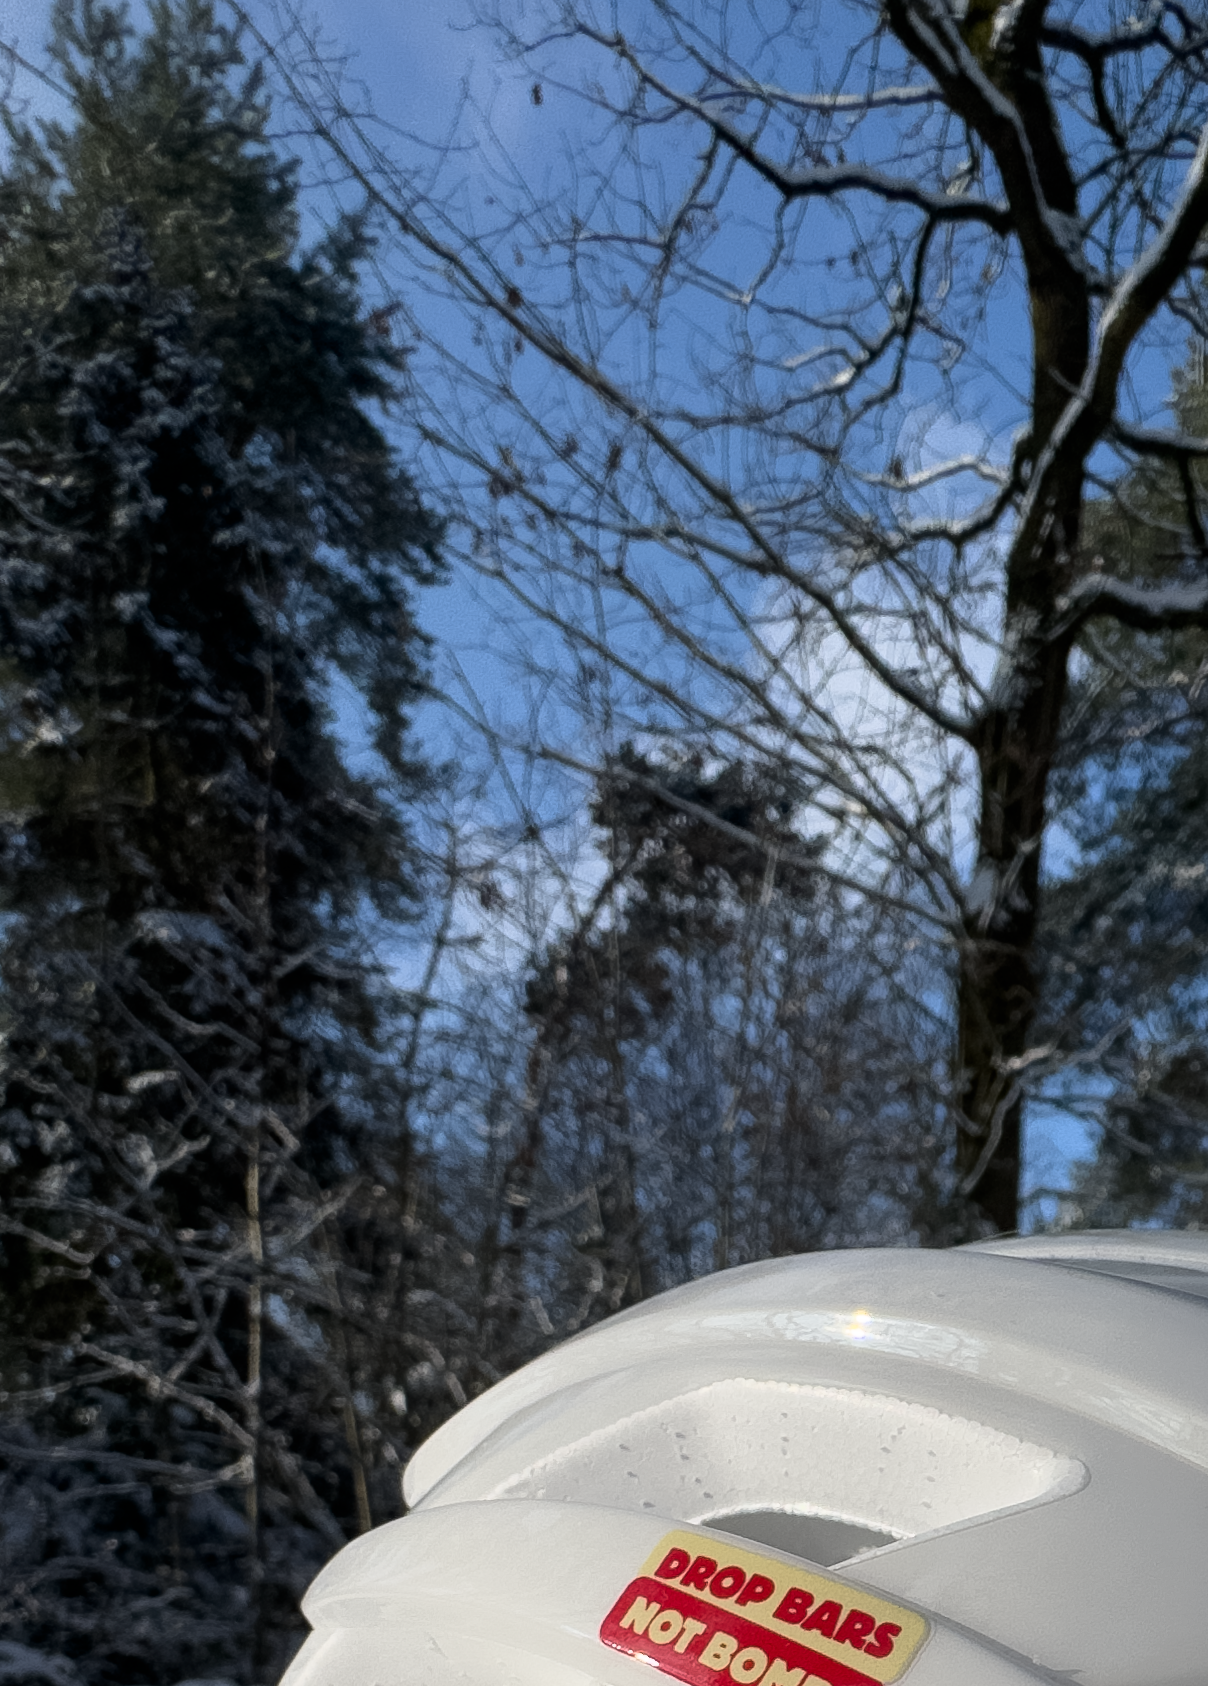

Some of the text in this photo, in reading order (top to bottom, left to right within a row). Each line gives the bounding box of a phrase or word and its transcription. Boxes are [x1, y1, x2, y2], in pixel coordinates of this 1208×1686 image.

[619, 1597, 706, 1654] NOT
[654, 1547, 902, 1658] DROP BARS
